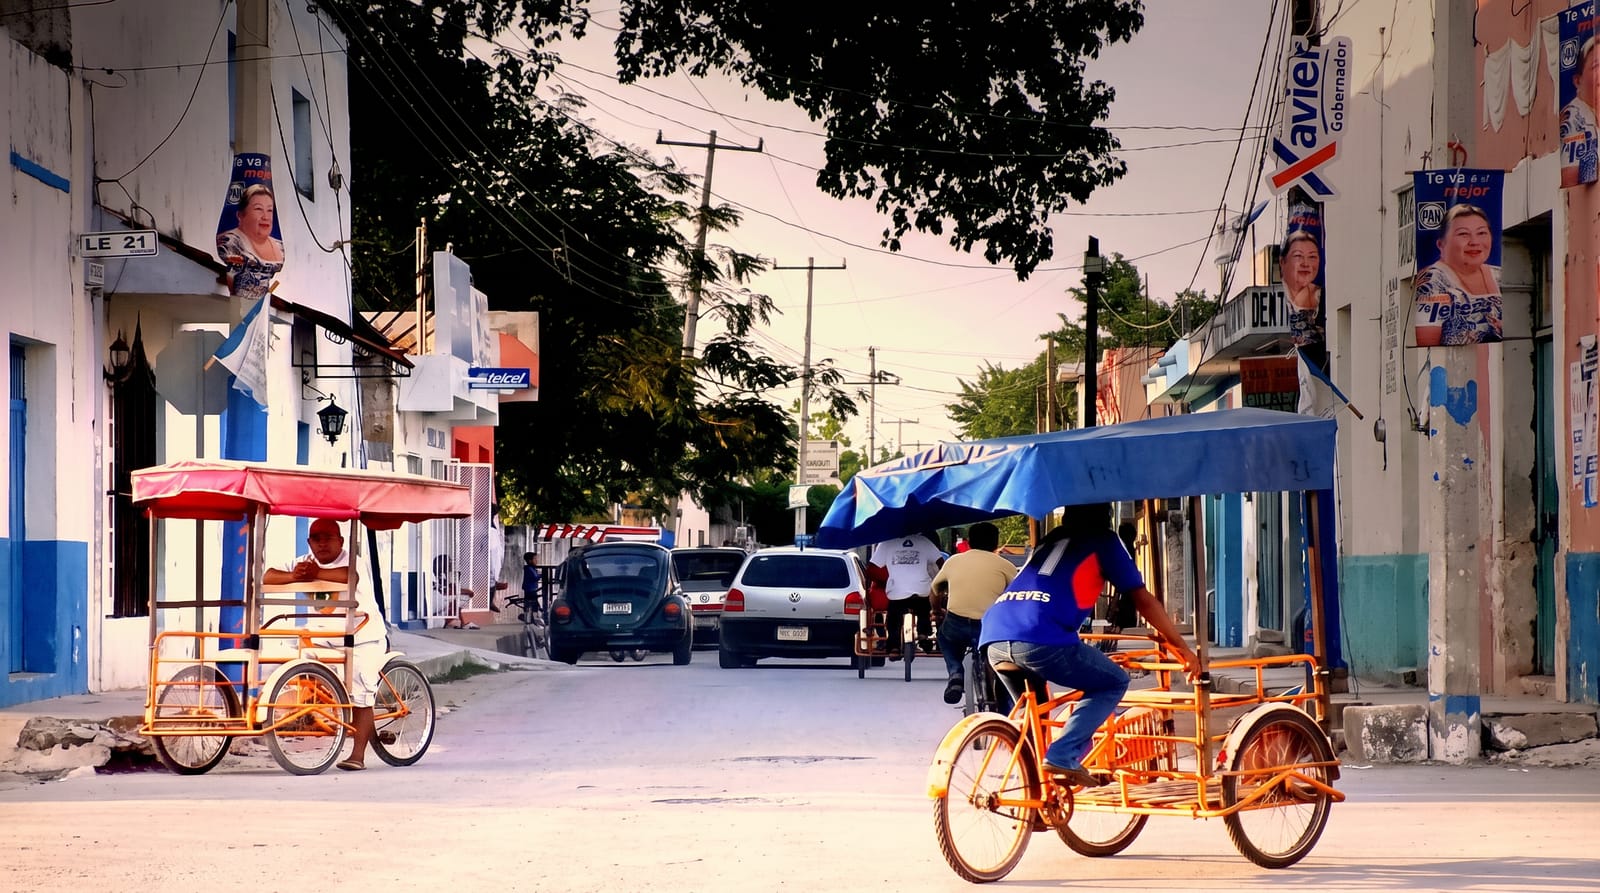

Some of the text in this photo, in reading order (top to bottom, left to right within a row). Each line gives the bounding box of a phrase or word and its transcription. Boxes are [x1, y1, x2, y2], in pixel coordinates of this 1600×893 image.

[1565, 11, 1578, 23] Te
[1331, 41, 1347, 132] Gobernador
[1272, 41, 1337, 195] Xavier
[247, 158, 262, 167] va
[1425, 172, 1444, 184] Te
[1449, 173, 1465, 184] va
[1444, 184, 1489, 199] mejor
[1422, 209, 1441, 222] PAN
[85, 235, 145, 251] LE 21
[487, 372, 527, 384] telcel
